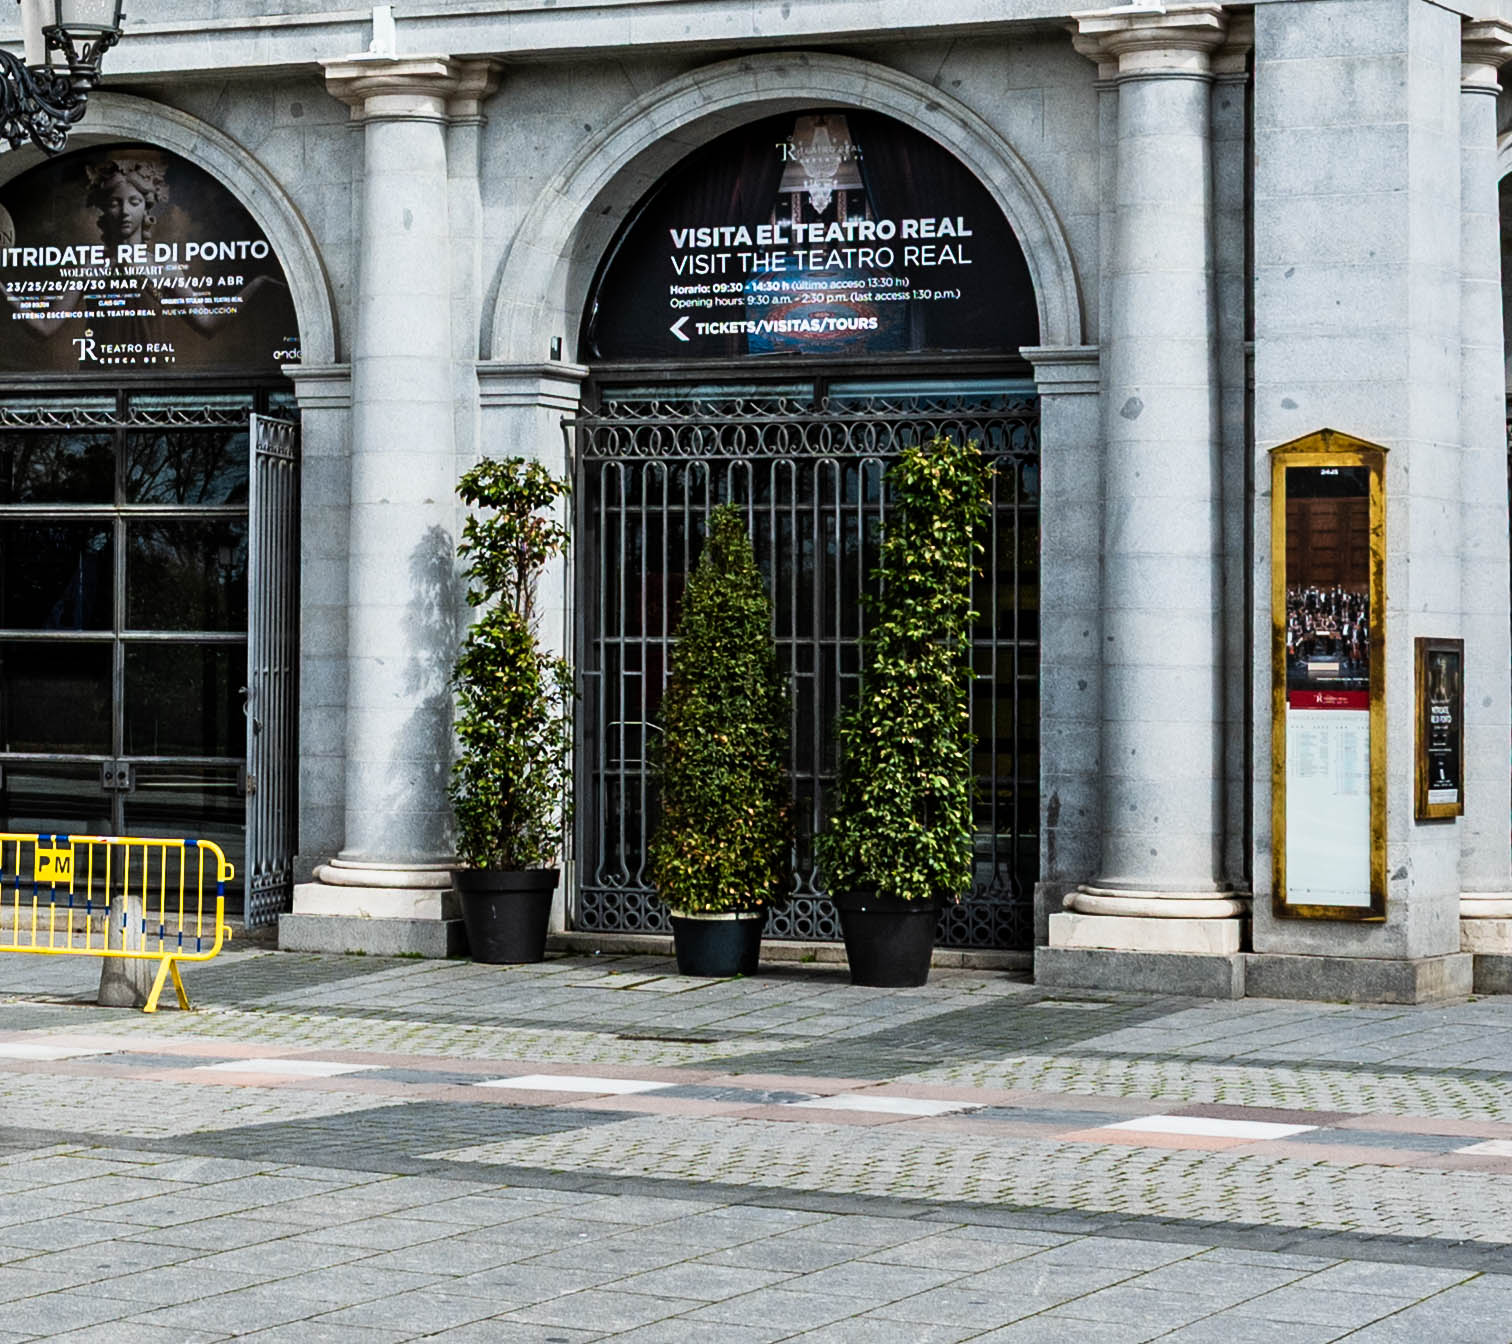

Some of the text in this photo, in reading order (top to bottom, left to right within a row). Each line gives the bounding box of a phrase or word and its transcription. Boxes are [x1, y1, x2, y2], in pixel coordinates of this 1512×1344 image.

[669, 216, 973, 249] VISITA EL TEATRO REAL
[117, 243, 148, 263] RE
[154, 242, 178, 263] DI
[184, 240, 270, 262] PONTO
[670, 244, 972, 276] VISIT THE TEATRO REAL
[6, 275, 244, 293] 23/25/26/28/30 MAR / 1/4/5/8/9 ABR
[669, 283, 710, 295] Horario:
[712, 282, 743, 293] 09:30
[752, 281, 780, 292] 14:30
[781, 281, 789, 291] h
[790, 279, 828, 291] (último
[829, 279, 865, 290] acceso
[867, 277, 894, 288] 13:30
[669, 289, 961, 309] Opening hours: 9:30 a.m. 2:30 p.m. (last access 1:30 p.m.)
[12, 312, 45, 320] ESTRENO
[96, 310, 105, 318] EL
[107, 309, 136, 317] TEATRO
[136, 309, 156, 317] REAL
[695, 316, 879, 336] TICKETS/VISITAS/TOURS
[72, 338, 175, 361] TR TEATRO REAL
[38, 855, 71, 874] PM
